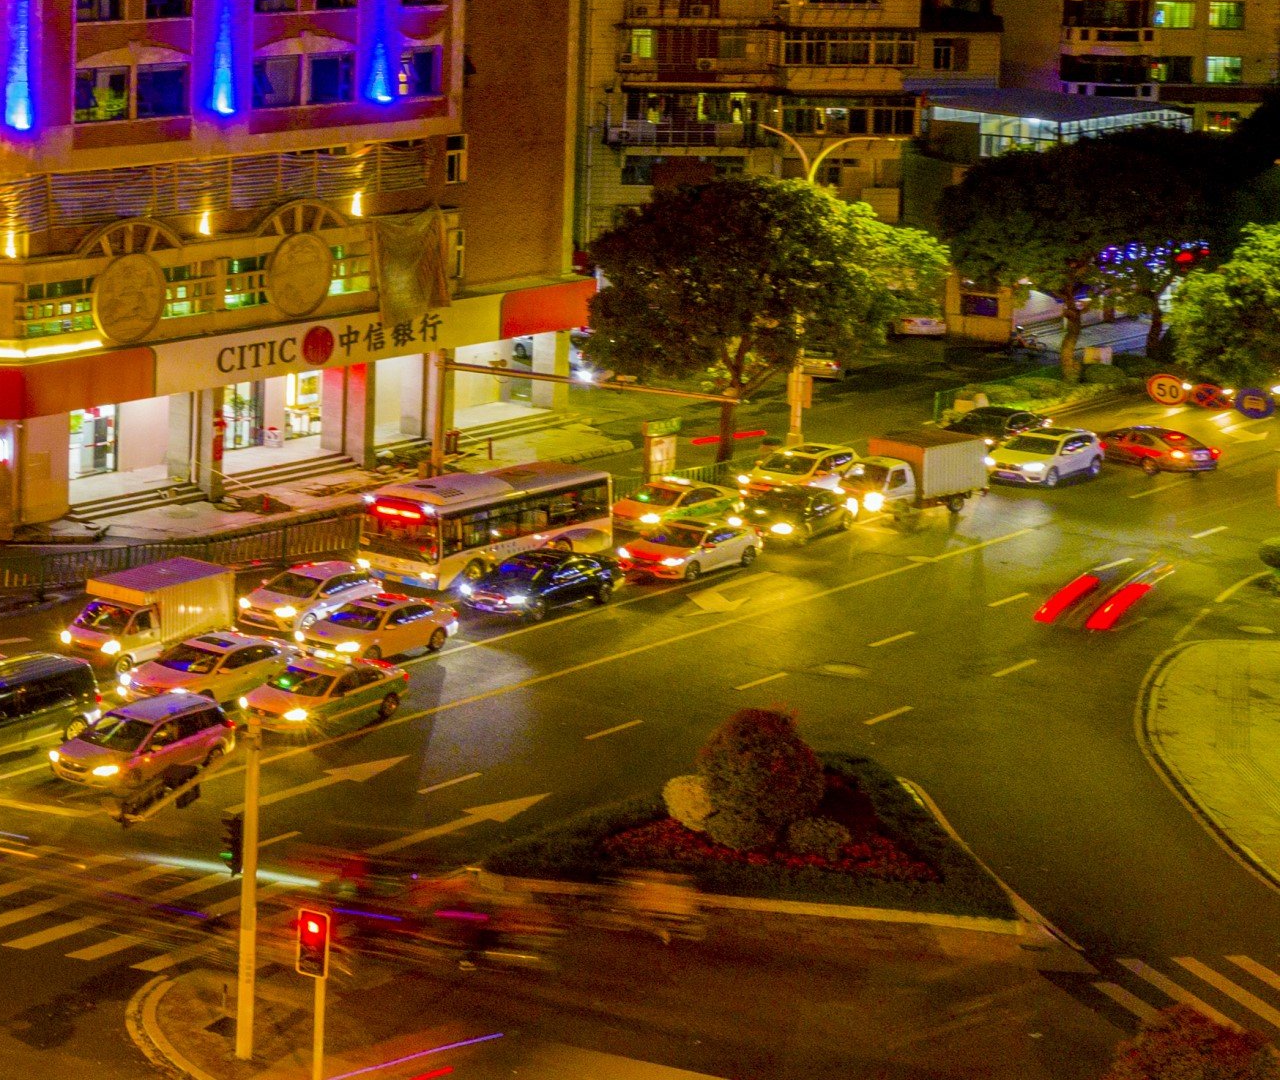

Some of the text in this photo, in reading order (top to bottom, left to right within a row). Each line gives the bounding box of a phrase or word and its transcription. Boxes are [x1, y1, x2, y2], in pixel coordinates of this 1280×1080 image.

[338, 313, 444, 357] 中信银行
[216, 336, 297, 374] CITIC
[1156, 383, 1180, 399] 50
